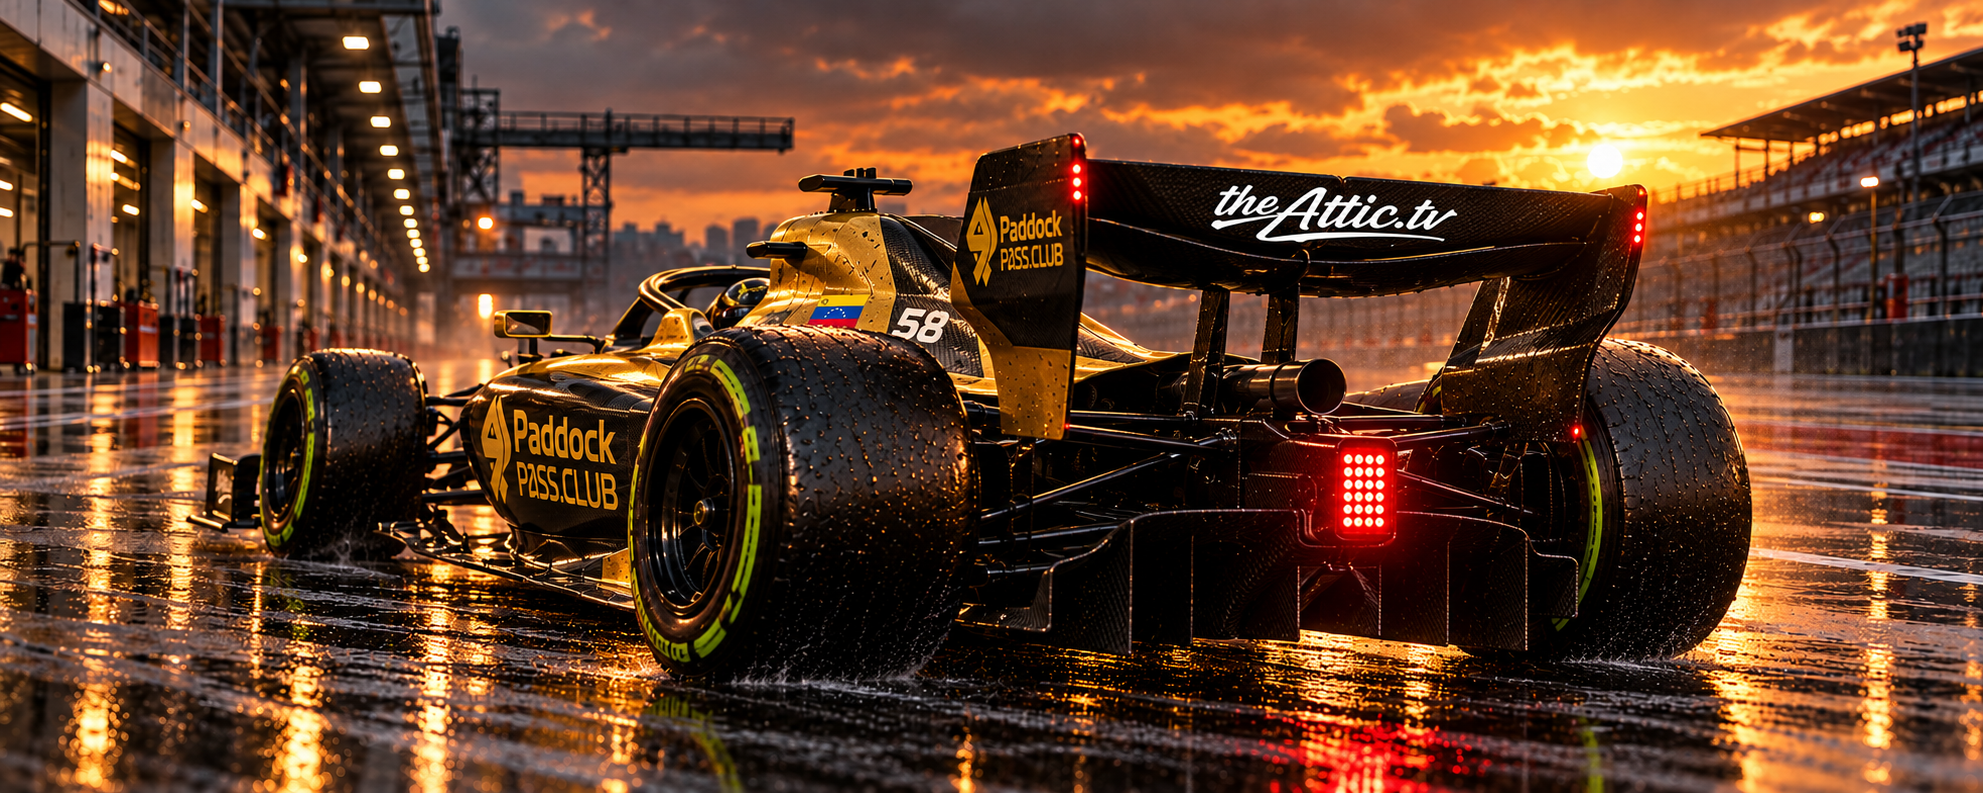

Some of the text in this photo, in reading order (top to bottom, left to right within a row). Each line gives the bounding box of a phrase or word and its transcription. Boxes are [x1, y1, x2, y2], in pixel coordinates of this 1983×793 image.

[1000, 210, 1062, 243] Paddock
[891, 307, 950, 343] 58
[513, 409, 617, 465] Paddock
